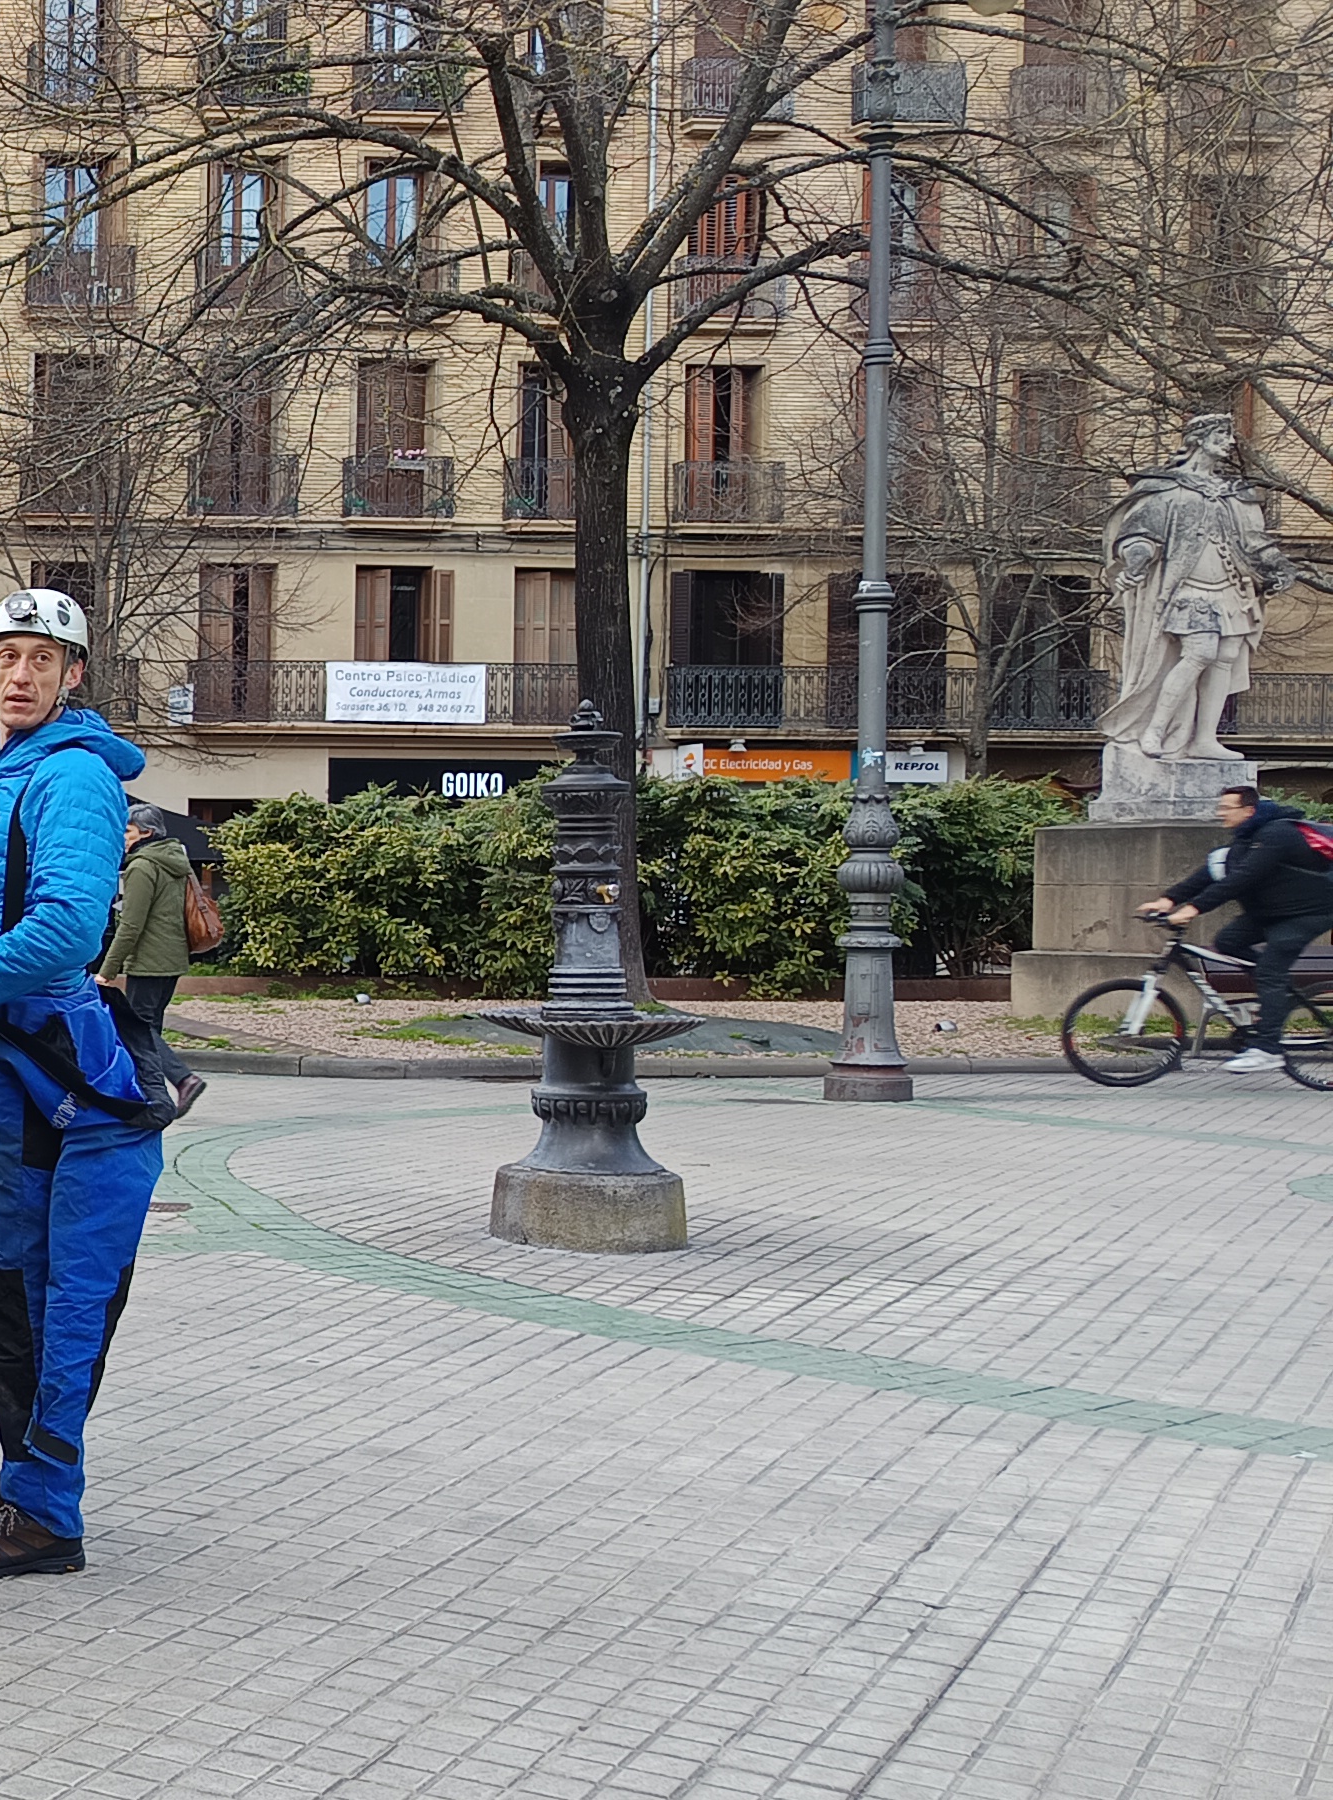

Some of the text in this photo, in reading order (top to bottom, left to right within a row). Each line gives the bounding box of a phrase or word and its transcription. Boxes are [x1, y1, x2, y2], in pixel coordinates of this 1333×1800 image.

[335, 669, 477, 684] Centro Psico-Médico
[349, 686, 462, 700] Conductores, Armas
[335, 701, 375, 712] Sarasate
[416, 704, 434, 713] 948
[436, 704, 448, 713] 20
[463, 704, 476, 714] 72
[720, 758, 782, 770] Electricidad
[784, 761, 790, 773] y
[793, 758, 813, 770] Gas
[894, 761, 941, 772] REPSOL
[441, 772, 503, 798] GOIKO
